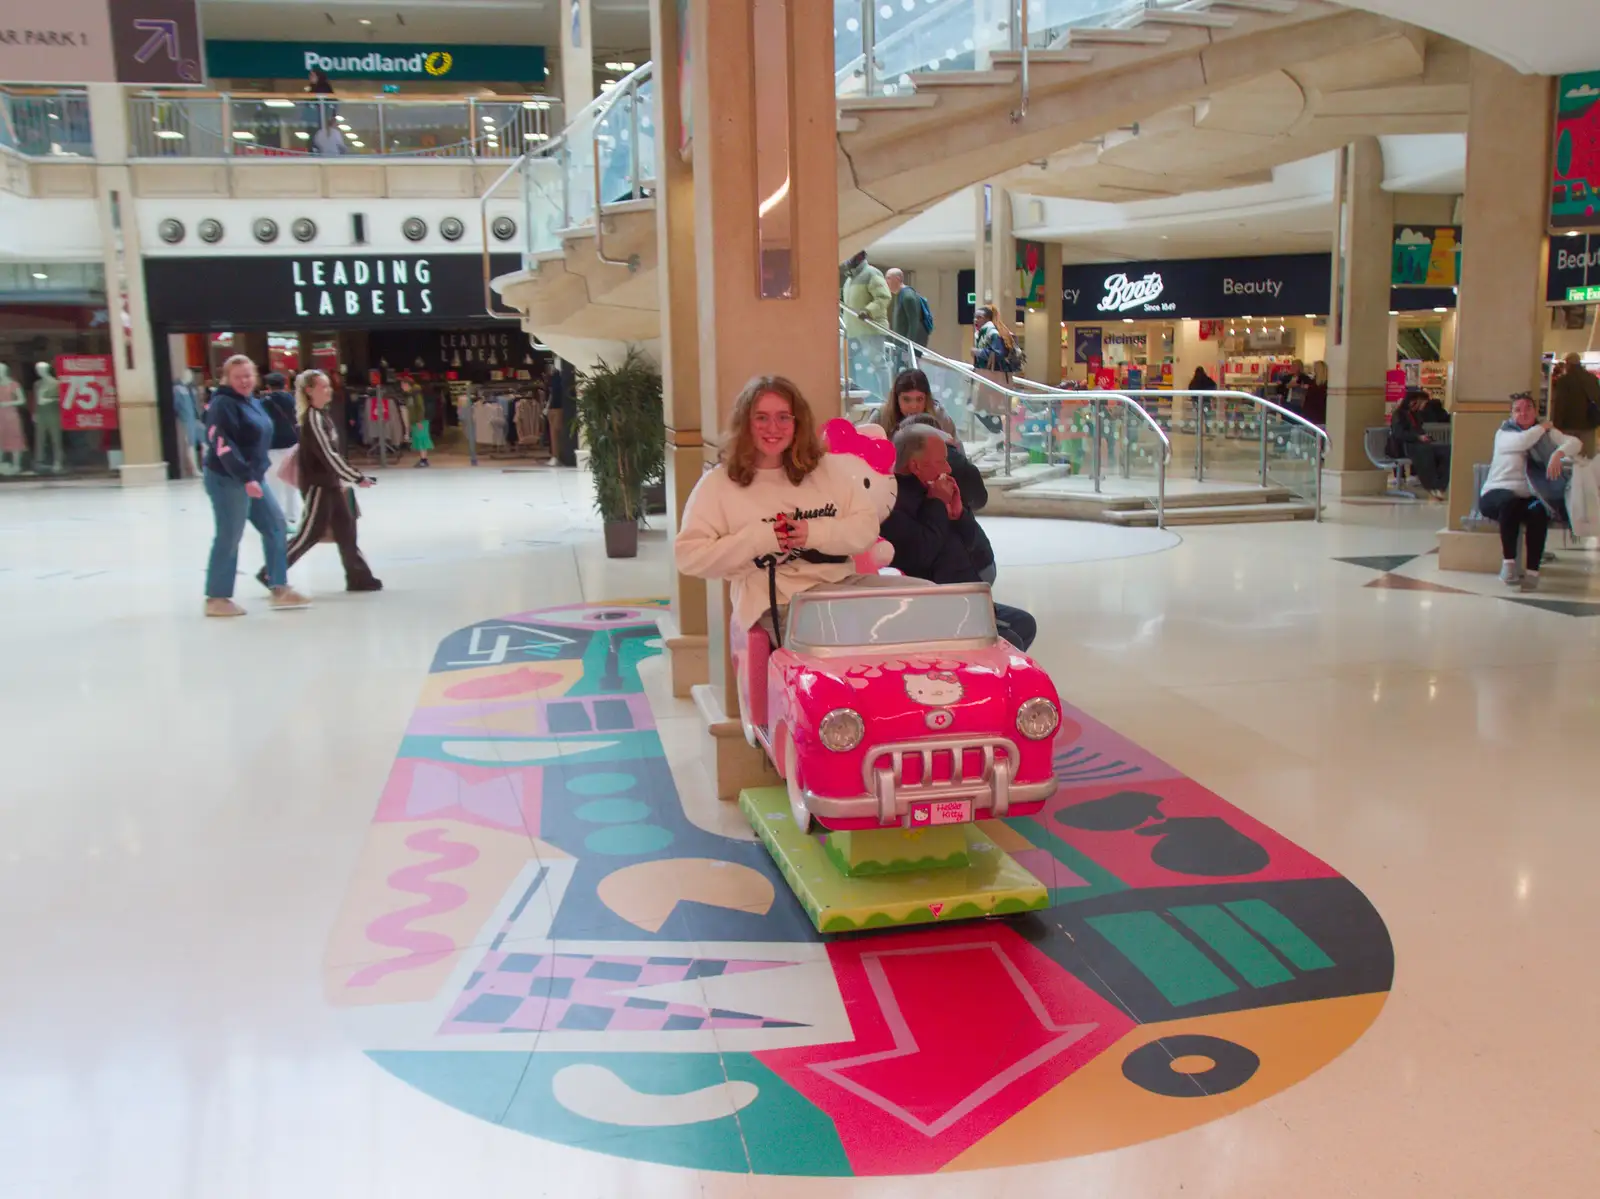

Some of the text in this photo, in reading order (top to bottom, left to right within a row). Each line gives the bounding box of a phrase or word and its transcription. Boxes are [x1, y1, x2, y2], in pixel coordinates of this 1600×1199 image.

[25, 30, 76, 46] PARK
[304, 51, 423, 72] Poundland
[292, 259, 431, 286] LEADING
[1061, 272, 1164, 311] cy Boots
[1223, 278, 1283, 298] Beauty
[295, 289, 433, 315] LABELS
[1143, 303, 1160, 312] Since
[440, 333, 508, 347] LEADING
[936, 802, 962, 811] Hello
[942, 811, 964, 822] Kitty
